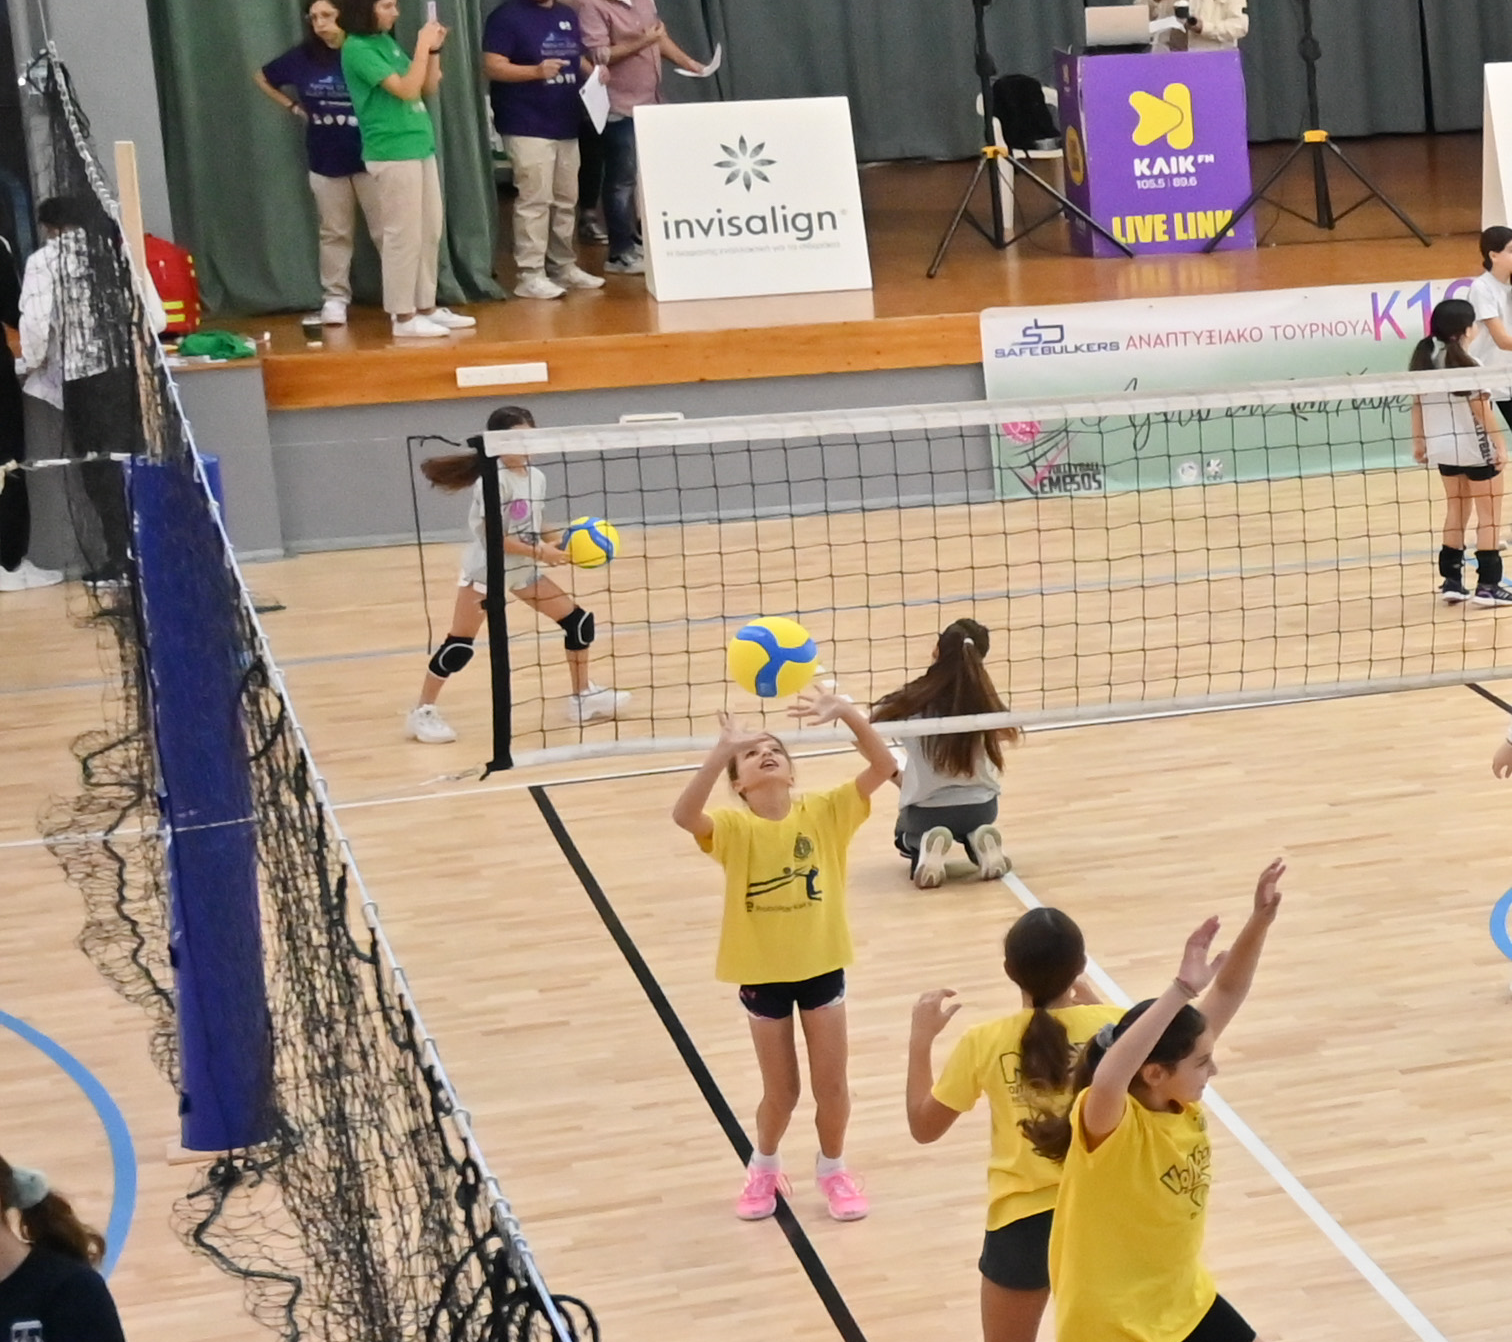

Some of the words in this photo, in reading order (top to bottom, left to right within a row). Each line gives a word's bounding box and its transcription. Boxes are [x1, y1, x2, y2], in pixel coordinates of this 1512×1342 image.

[662, 204, 838, 242] invisalign
[1112, 214, 1170, 244] LIVE
[1174, 210, 1236, 241] LINK
[994, 340, 1120, 359] SAFEBULKERS
[1125, 326, 1263, 351] ΑΝΑΠΤΥΞΙΑΚΟ
[1269, 319, 1373, 342] ΤΟΥΡΝΟΥΑ
